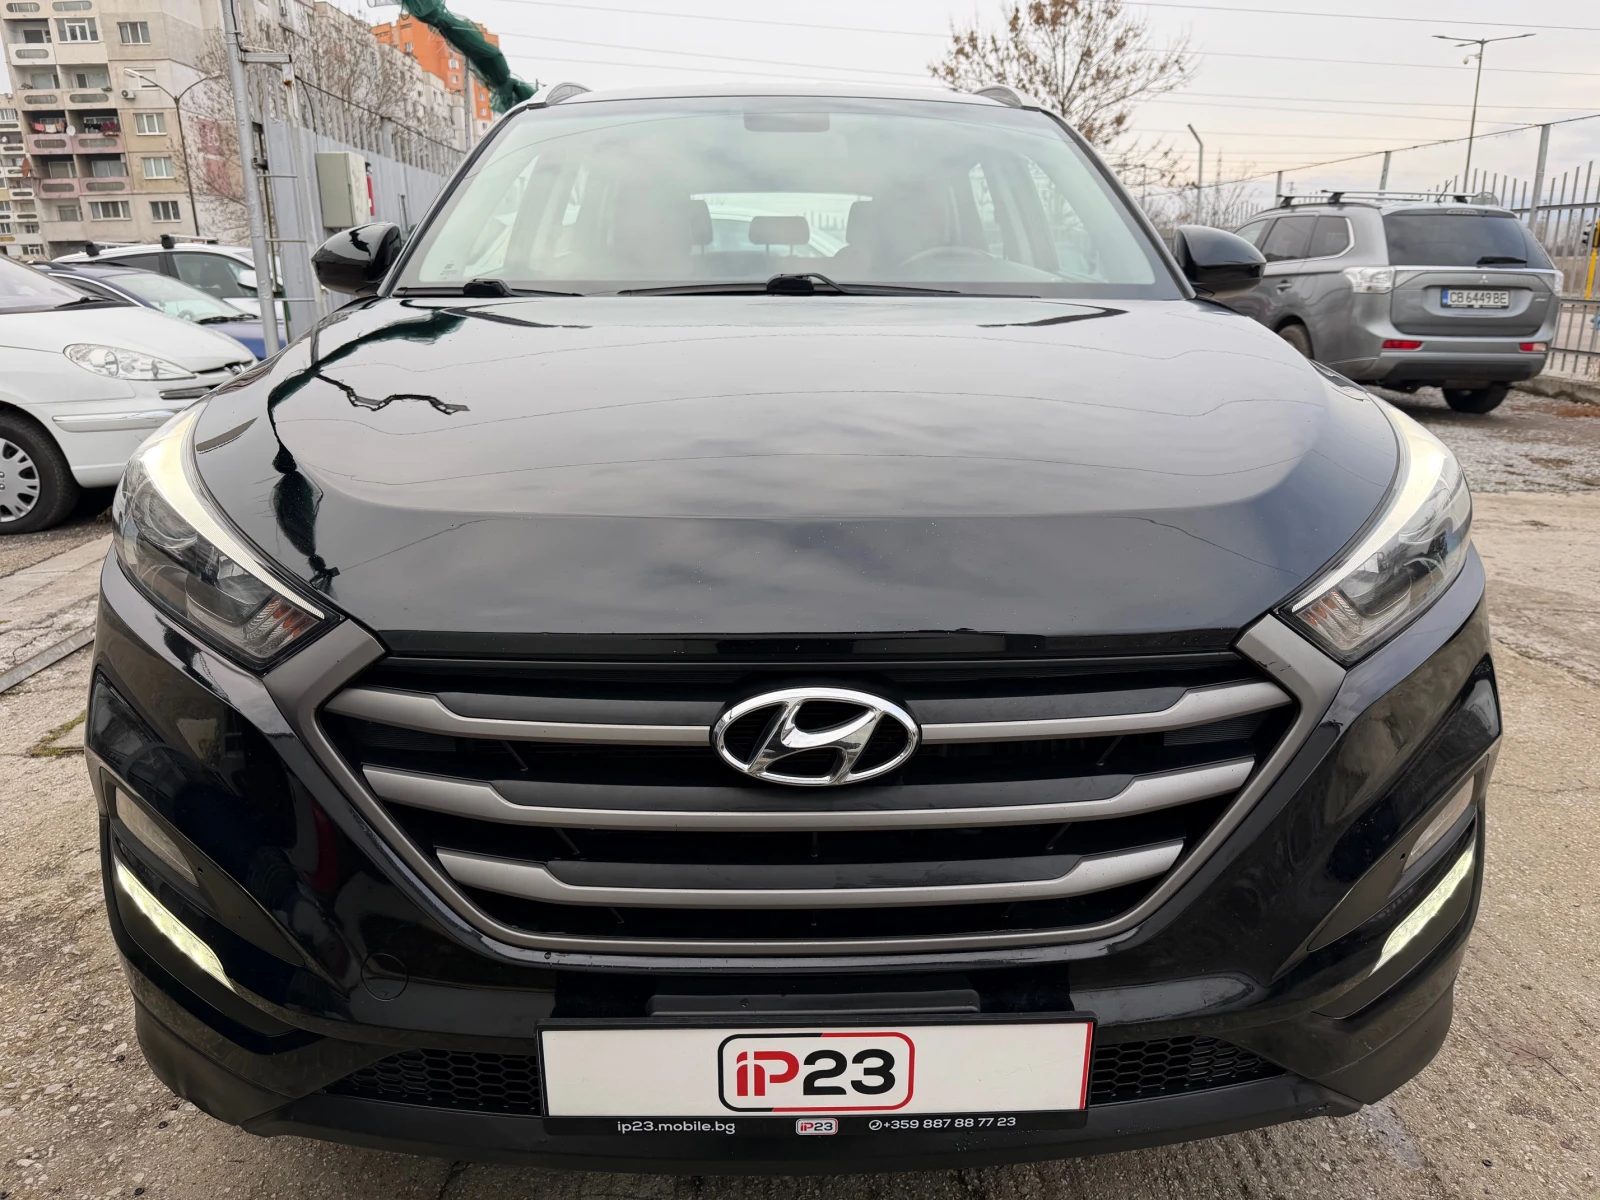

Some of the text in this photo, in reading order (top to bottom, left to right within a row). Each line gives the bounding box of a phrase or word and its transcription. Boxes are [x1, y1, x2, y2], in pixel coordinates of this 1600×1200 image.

[617, 1121, 736, 1135] ip23.mobile.bg
[883, 1116, 1016, 1129] +359 887 88 77 23
